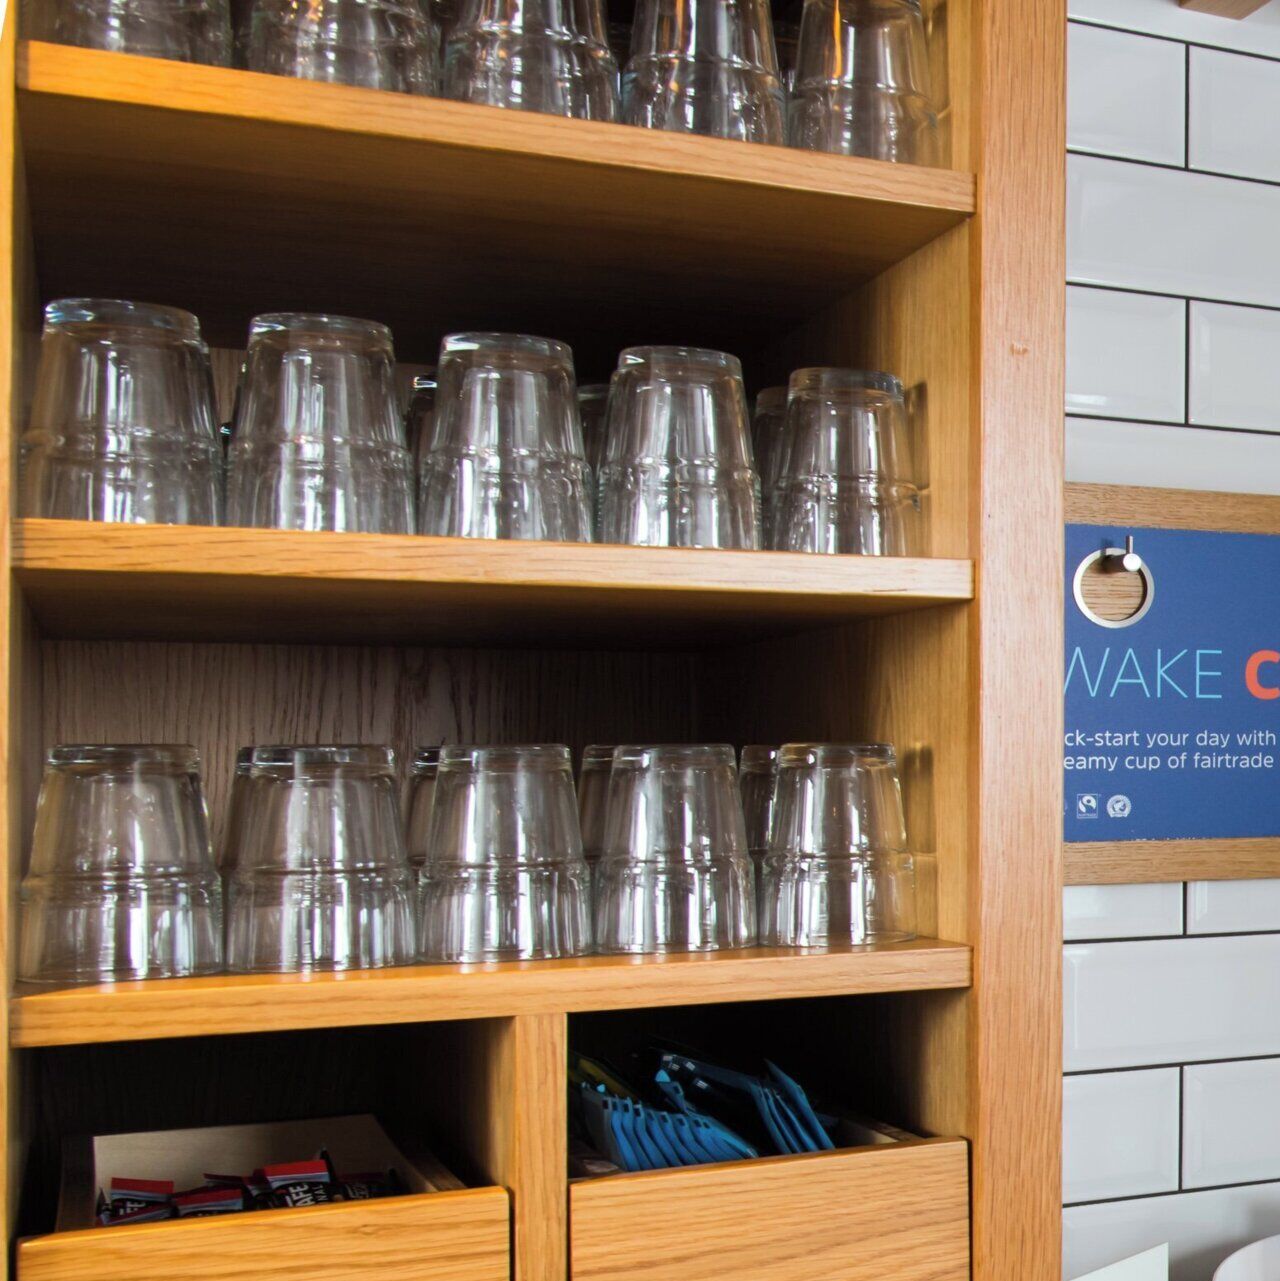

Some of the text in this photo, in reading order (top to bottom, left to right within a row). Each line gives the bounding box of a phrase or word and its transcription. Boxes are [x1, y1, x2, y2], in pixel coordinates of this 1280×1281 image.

[1063, 646, 1223, 699] WAKE
[1063, 729, 1140, 747] ck-start
[1146, 732, 1190, 748] your
[1195, 729, 1231, 748] day
[1236, 729, 1277, 746] with
[1063, 755, 1118, 772] eamy
[1124, 755, 1161, 771] cup
[1167, 751, 1188, 769] of
[1192, 752, 1274, 769] fairtrade
